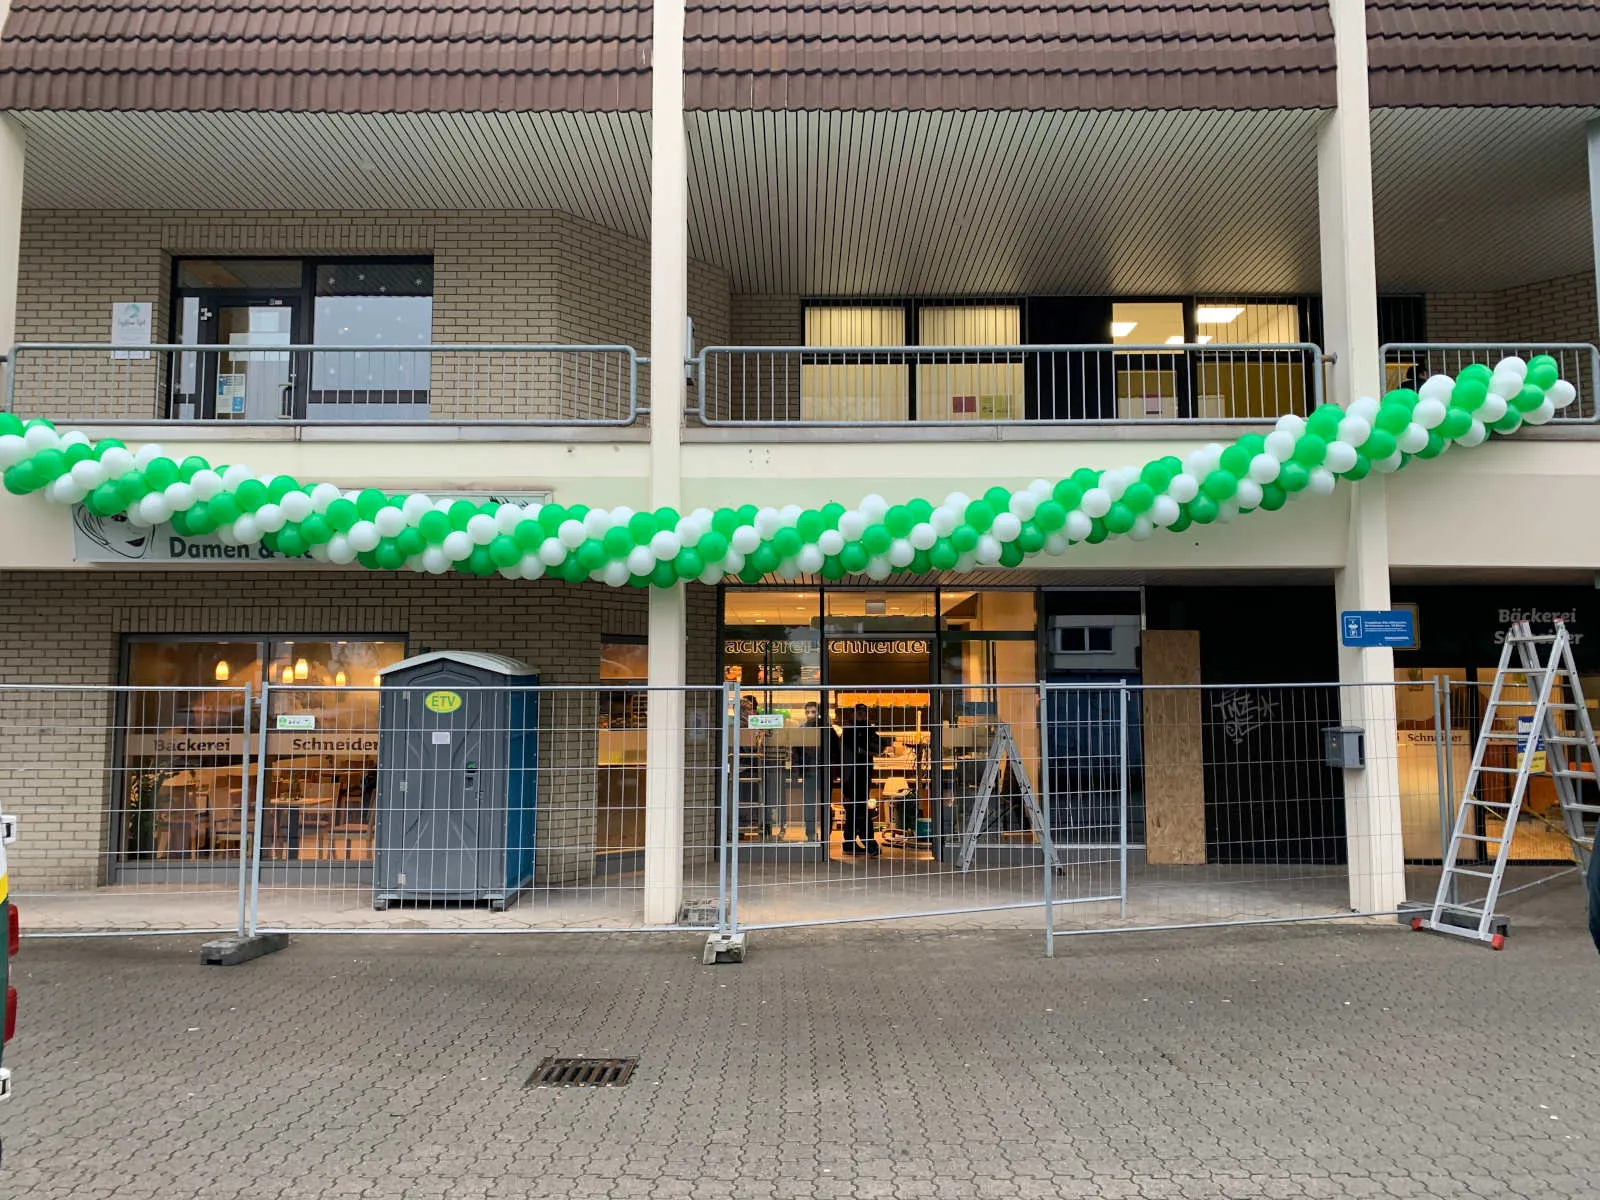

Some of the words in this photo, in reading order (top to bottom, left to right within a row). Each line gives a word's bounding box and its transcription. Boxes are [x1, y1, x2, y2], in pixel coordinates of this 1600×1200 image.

[168, 536, 250, 559] Damen
[1498, 607, 1577, 623] Bäckerei
[431, 695, 456, 707] ETV
[292, 737, 379, 751] Schneider
